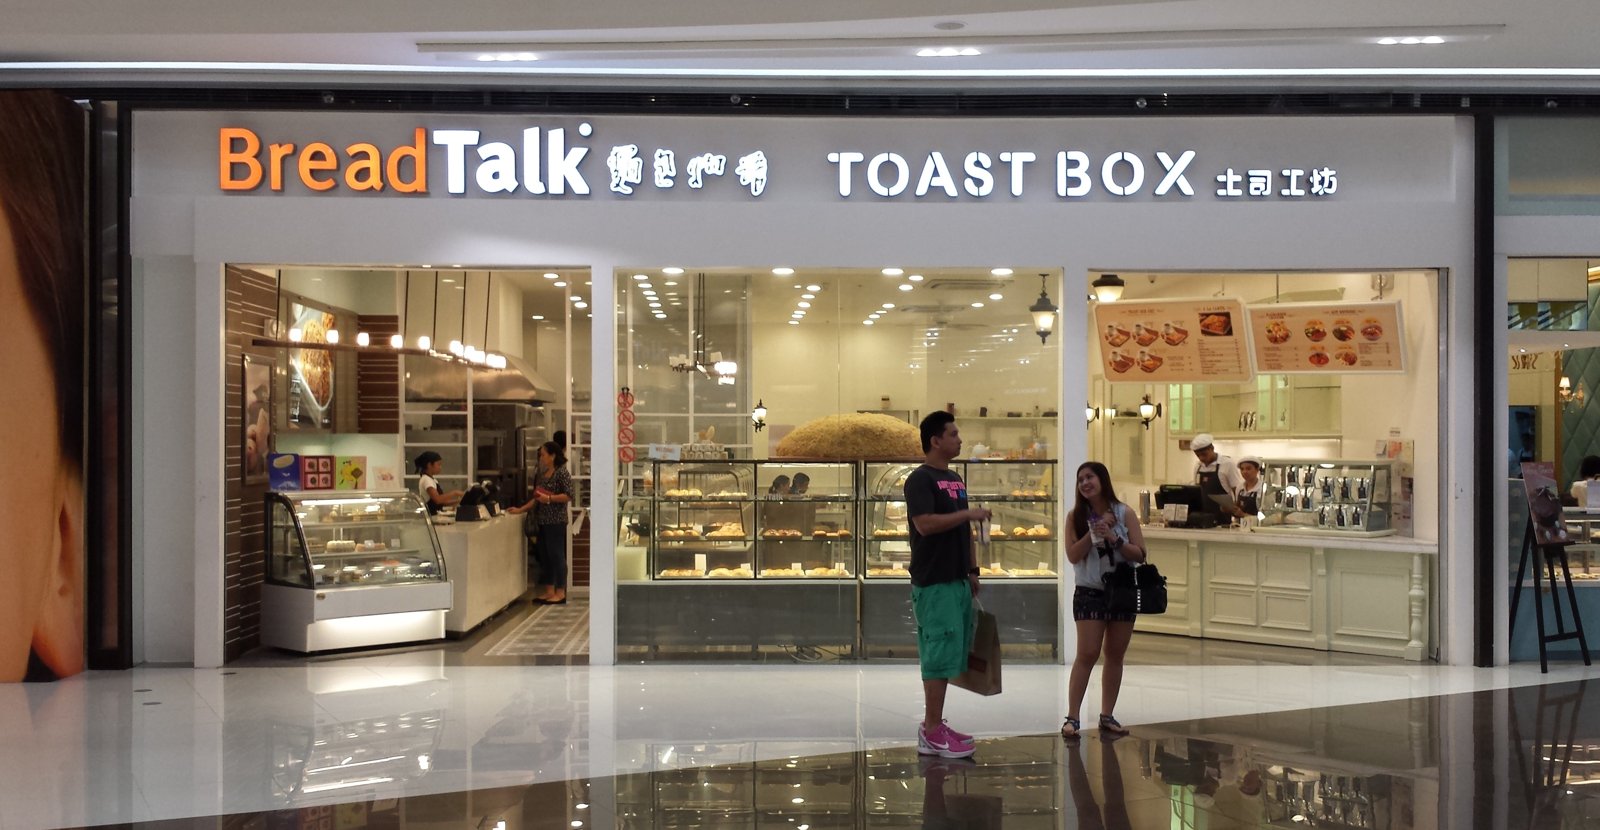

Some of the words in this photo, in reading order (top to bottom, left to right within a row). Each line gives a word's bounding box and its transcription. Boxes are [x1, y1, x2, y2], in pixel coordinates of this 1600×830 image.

[219, 126, 590, 194] BreadTalk
[827, 151, 1036, 197] TOAST
[1056, 150, 1196, 197] BOX
[1216, 167, 1338, 196] 土司工坊
